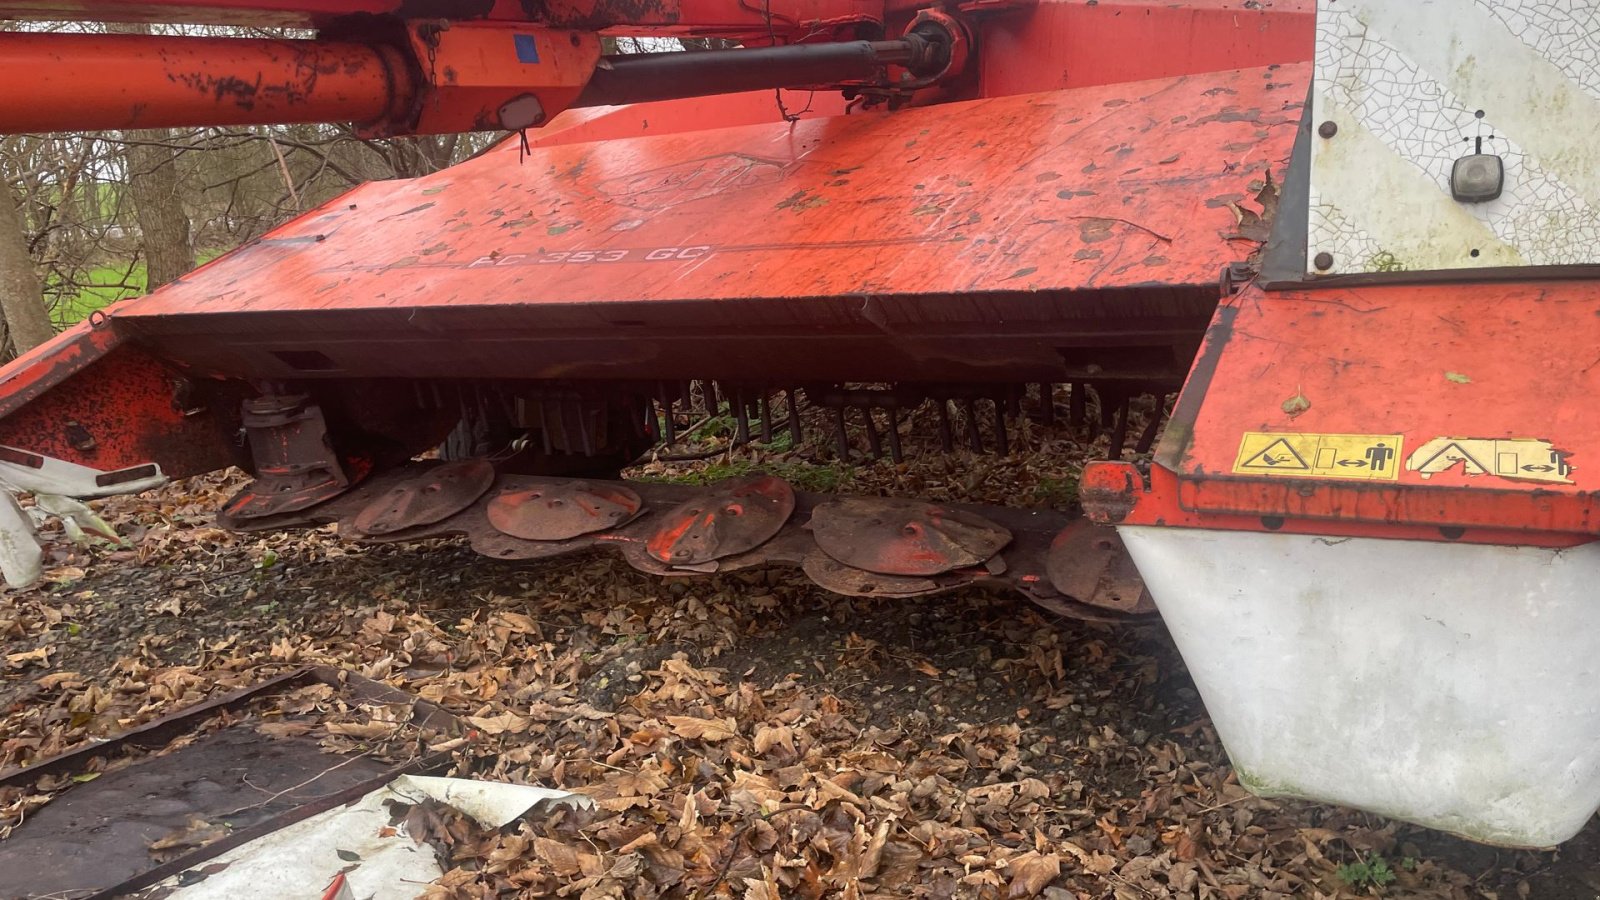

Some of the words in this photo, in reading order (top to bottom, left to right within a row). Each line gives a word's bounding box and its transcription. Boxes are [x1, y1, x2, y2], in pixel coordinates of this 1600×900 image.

[467, 254, 527, 268] FC
[538, 249, 630, 263] 353
[644, 245, 711, 261] GC
